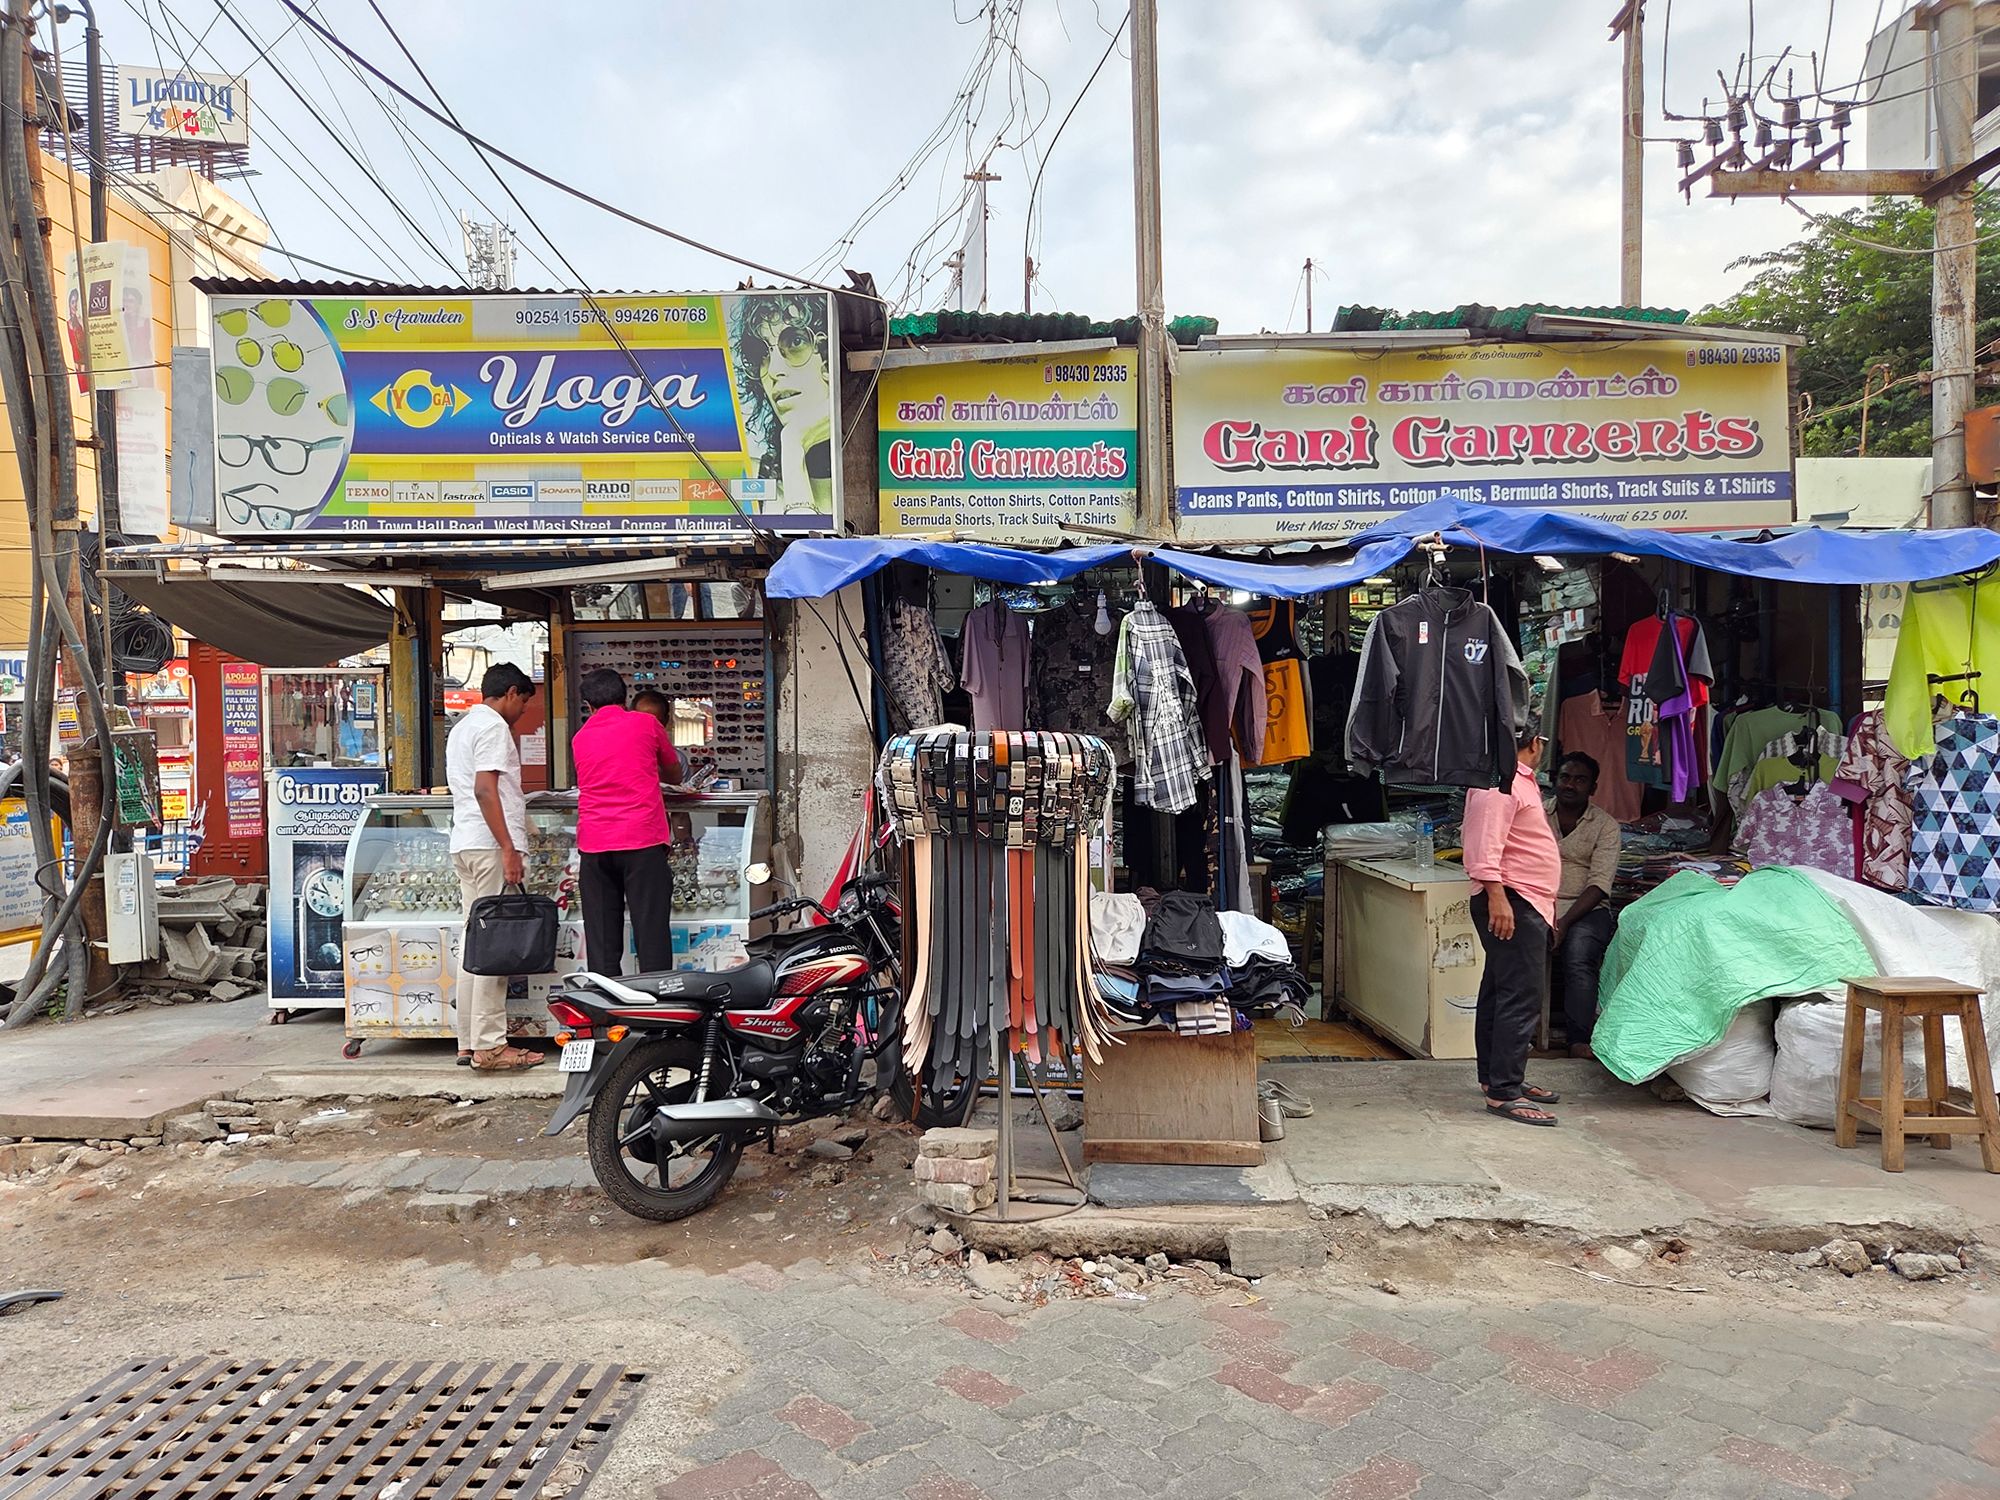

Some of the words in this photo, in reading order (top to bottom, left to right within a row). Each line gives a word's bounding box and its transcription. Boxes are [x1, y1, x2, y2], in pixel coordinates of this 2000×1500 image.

[345, 308, 380, 327] S.S.
[384, 308, 464, 331] Azarudeen
[515, 310, 559, 324] 90254
[615, 309, 658, 323] 99426
[663, 308, 706, 322] 70768
[1699, 348, 1737, 365] 98430
[1741, 347, 1780, 364] 29335
[1055, 365, 1089, 382] 98430
[1093, 365, 1127, 381] 29335
[480, 355, 706, 428] Yoga
[1283, 375, 1368, 406] கனி
[1377, 365, 1679, 403] கார்மெண்ட்ஸ்
[898, 394, 945, 422] கனி
[952, 392, 1118, 422] கார்மெண்ட்ஸ்
[490, 432, 541, 447] Opticals
[546, 432, 555, 444] &
[559, 431, 598, 444] Watch
[602, 431, 650, 444] Service
[1203, 415, 1379, 472] Gani
[1392, 410, 1763, 468] Garments
[888, 438, 965, 481] Gani
[969, 440, 1128, 482] Garments
[347, 488, 389, 497] TEXMO
[396, 492, 434, 500] TITAN
[494, 487, 528, 496] CASIO
[587, 483, 630, 494] RADO
[645, 486, 678, 494] CITIZEN
[1189, 492, 1233, 509] Jeans
[1237, 491, 1282, 509] Pants,
[1286, 490, 1335, 507] Cotton
[1337, 488, 1385, 507] Shirts,
[1389, 487, 1437, 505] Cotton
[1490, 483, 1557, 501] Bermuda
[1561, 481, 1613, 500] Shorts,
[1617, 480, 1657, 498] Track
[1662, 479, 1699, 496] Suits
[1704, 478, 1715, 494] &
[1720, 476, 1776, 495] T.Shirts
[893, 495, 926, 507] Jeans
[930, 495, 965, 509] Pants,
[968, 495, 1006, 507] Cotton
[1009, 494, 1045, 509] Shirts,
[1048, 494, 1086, 507] Cotton
[1089, 494, 1124, 508] Pants,
[901, 513, 951, 526] Bermuda
[955, 513, 995, 527] Shorts,
[998, 512, 1028, 525] Track
[1032, 512, 1059, 525] Suits
[1063, 513, 1071, 524] &
[1075, 512, 1117, 525] T.Shirts
[1631, 510, 1659, 522] 625
[1663, 509, 1688, 521] 001.
[494, 520, 529, 530] West
[533, 520, 566, 530] Masi
[1275, 520, 1306, 532] West
[1308, 520, 1341, 532] Masi
[1342, 519, 1379, 530] Street
[1464, 643, 1488, 661] 07
[1263, 665, 1289, 694] ST
[227, 760, 258, 768] APOLLO
[351, 810, 360, 820] &
[829, 945, 858, 954] HONDA
[740, 1017, 786, 1027] Shine
